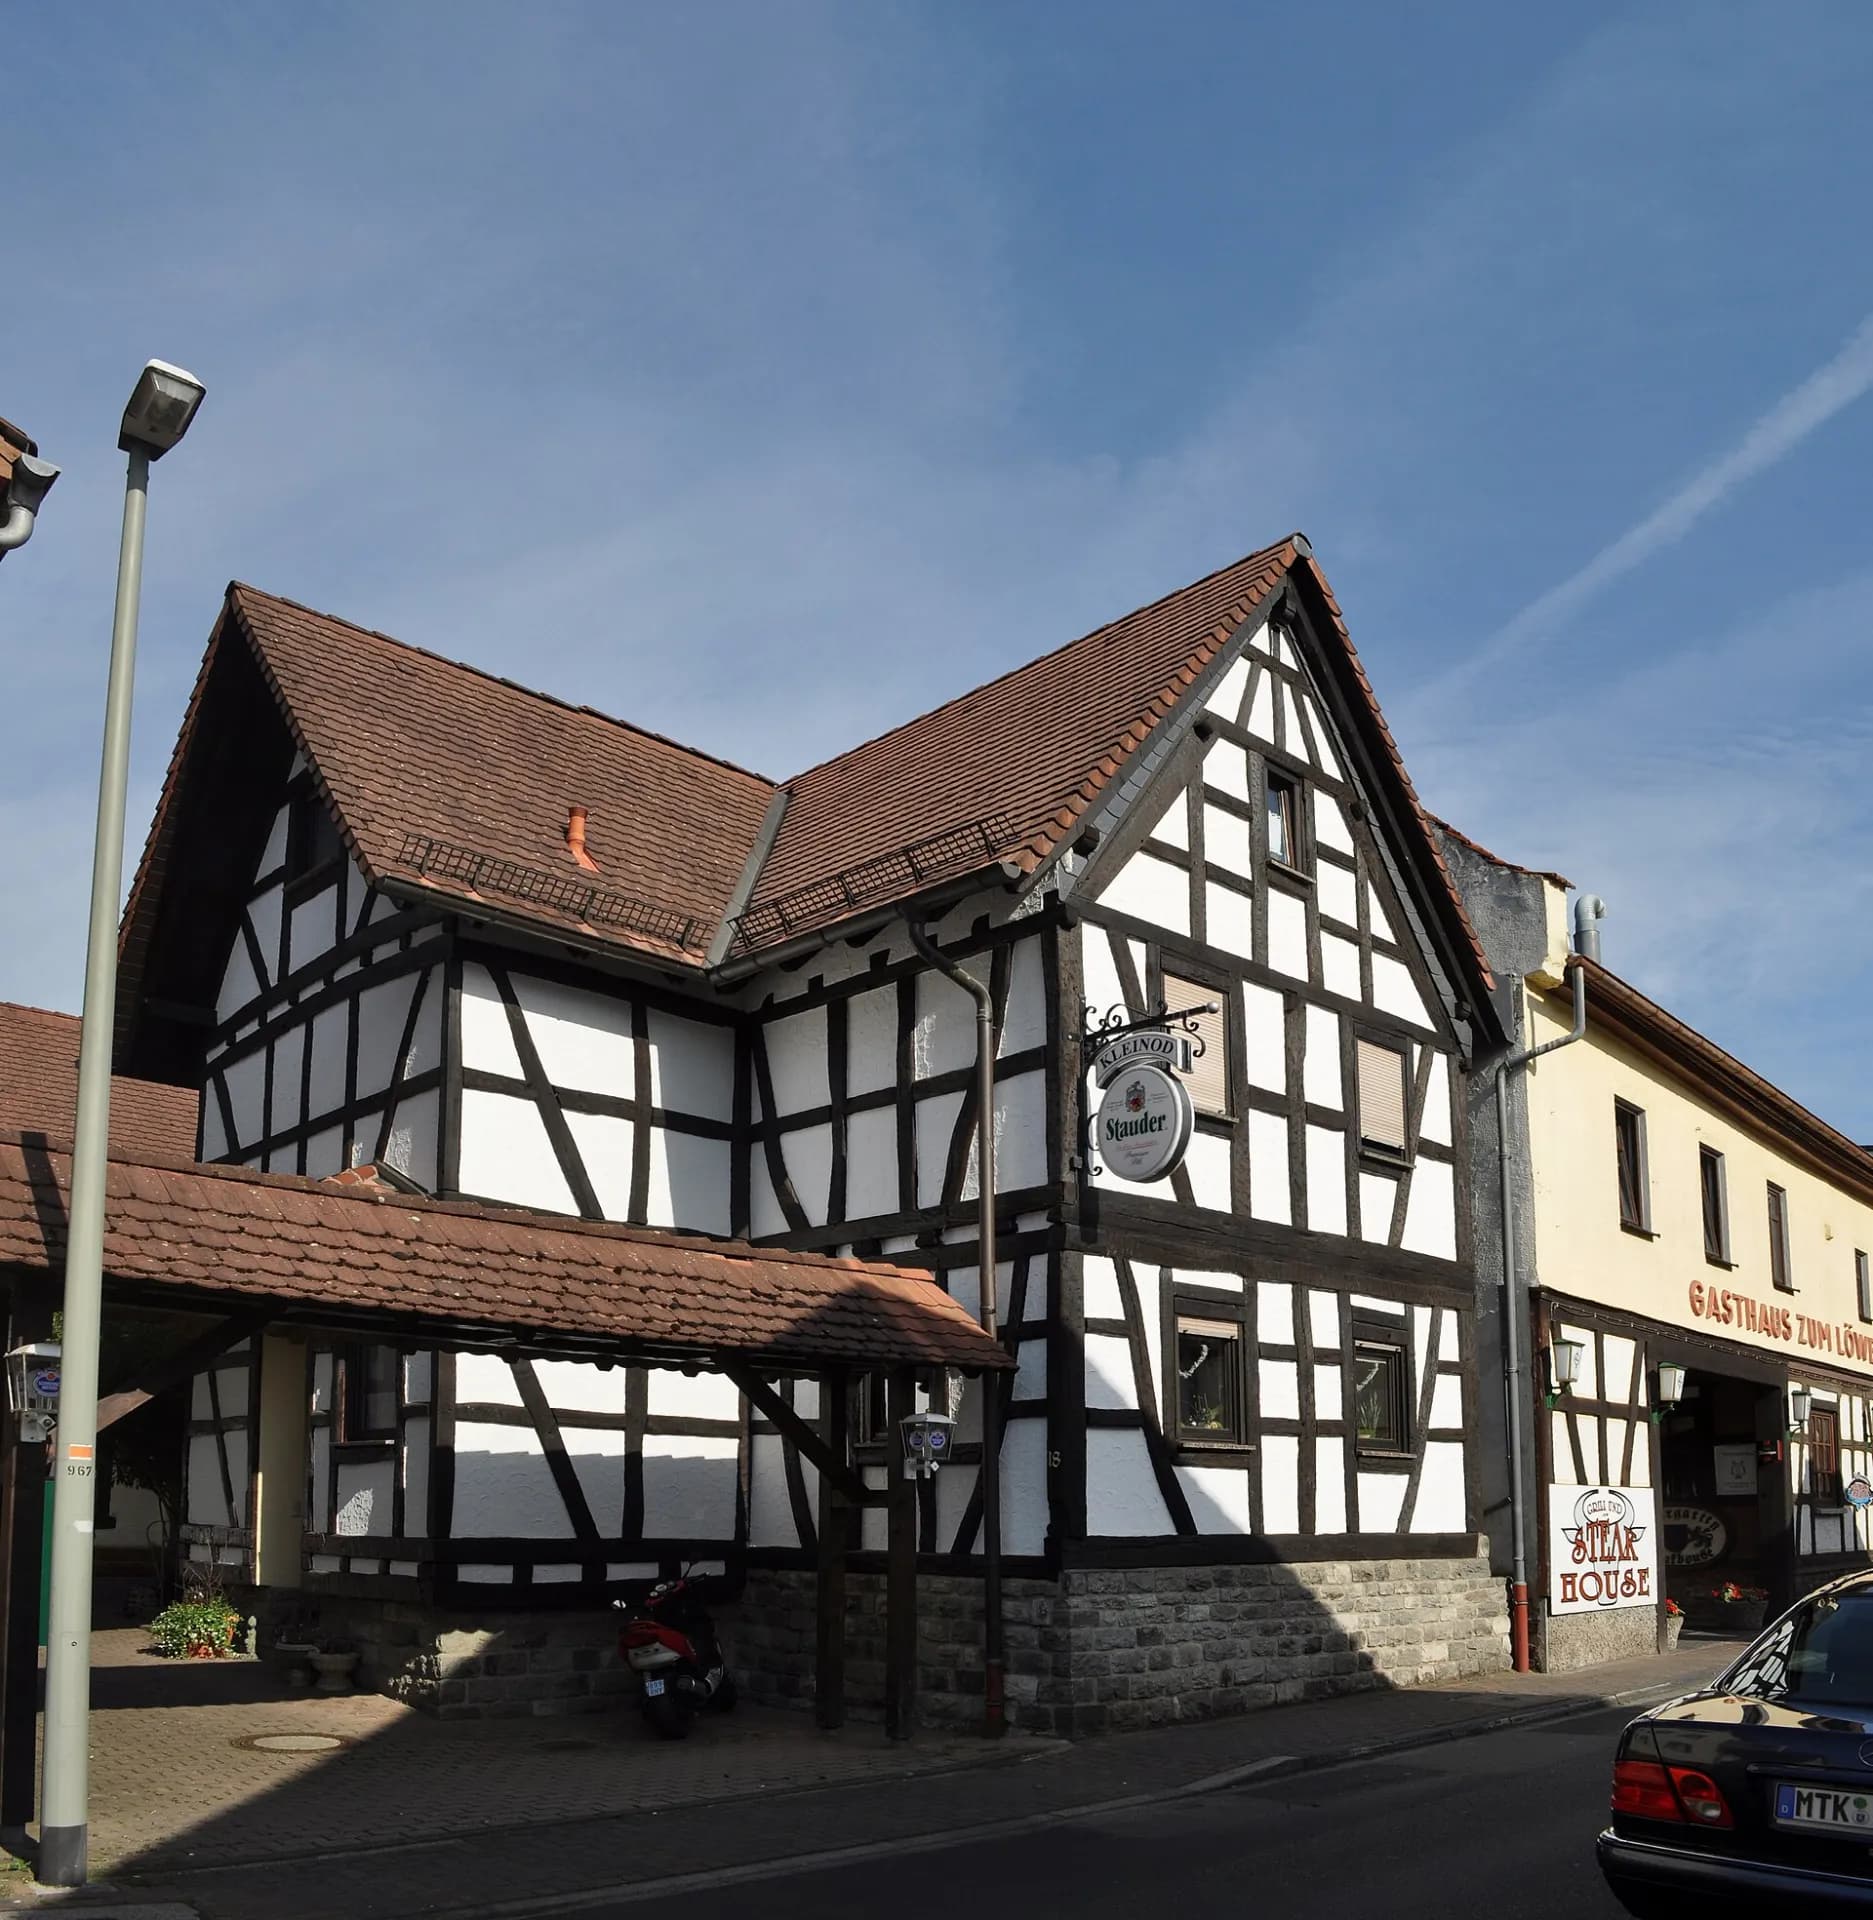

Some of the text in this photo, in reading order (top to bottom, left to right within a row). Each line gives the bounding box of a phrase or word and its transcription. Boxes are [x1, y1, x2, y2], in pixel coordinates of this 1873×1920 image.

[1100, 1037, 1174, 1069] KLEINOD
[1106, 1111, 1166, 1141] Stauder
[1689, 1280, 1792, 1341] GASTHAUS
[1796, 1314, 1832, 1352] ZUM
[68, 1465, 92, 1475] 967
[1572, 1518, 1639, 1564] STEAK
[1560, 1567, 1649, 1602] HOUSE
[1782, 1791, 1850, 1822] D MTK
